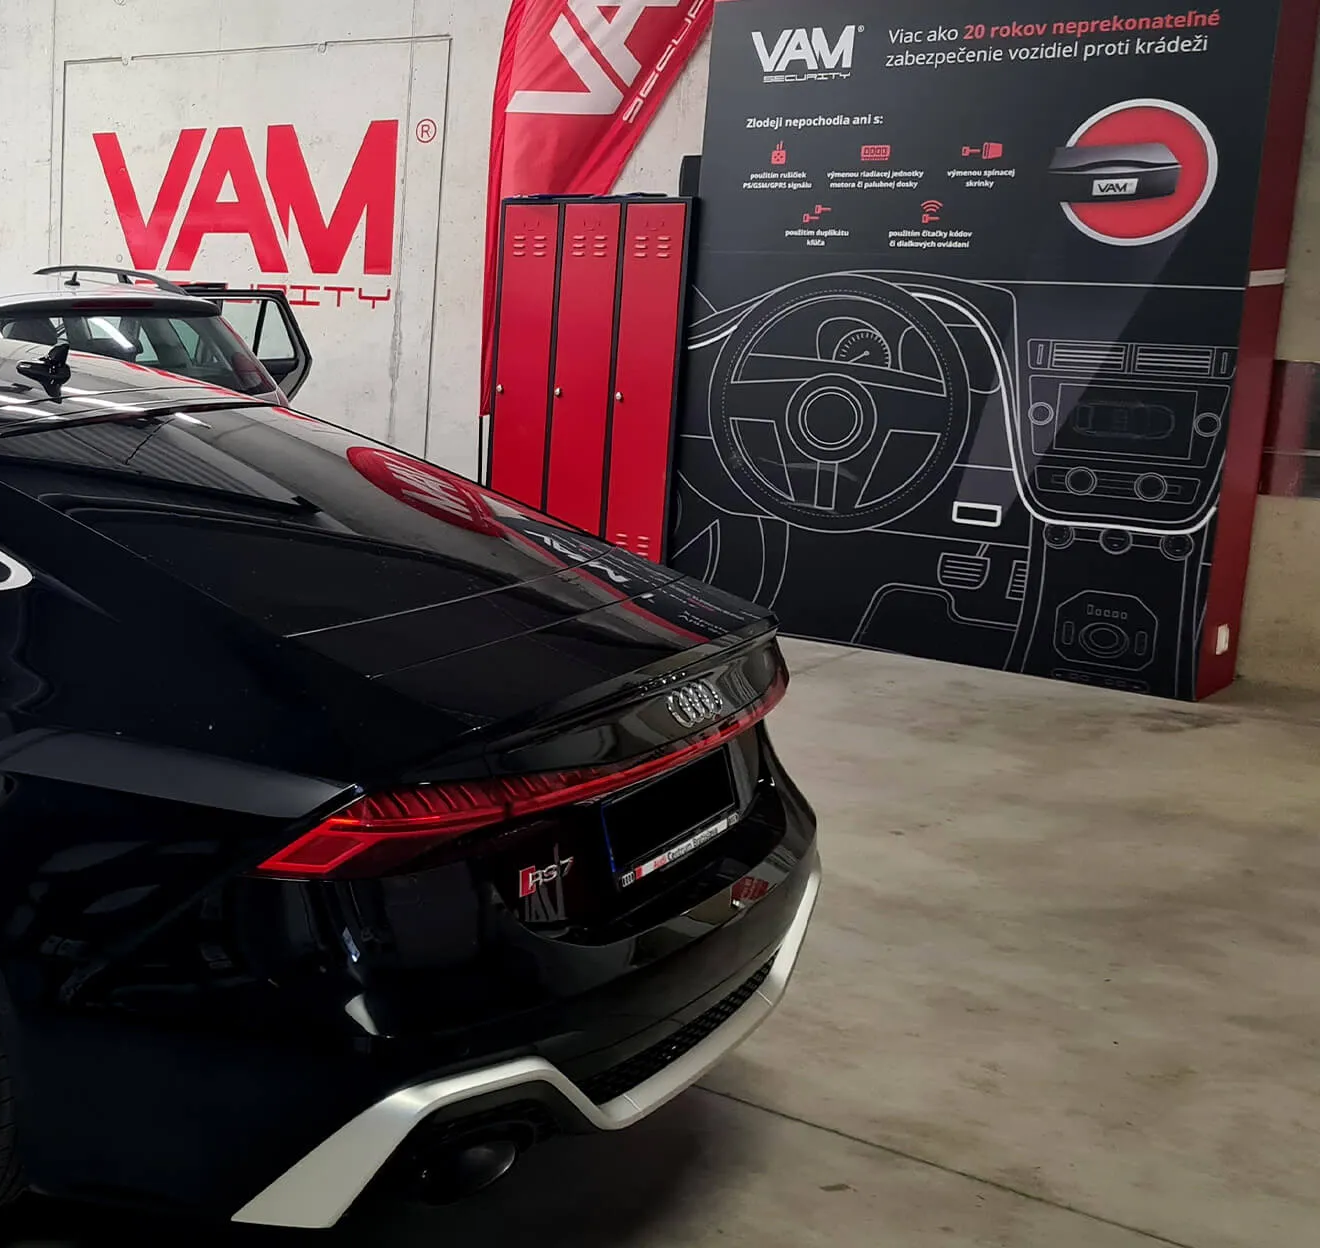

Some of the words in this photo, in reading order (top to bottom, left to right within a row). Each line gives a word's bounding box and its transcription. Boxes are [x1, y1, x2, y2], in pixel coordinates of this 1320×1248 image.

[888, 28, 923, 44] Viac
[927, 26, 959, 42] ako
[963, 24, 986, 40] 20
[990, 21, 1047, 38] rokov
[1052, 9, 1221, 37] neprekonateľné
[751, 25, 856, 73] VAM
[885, 46, 1003, 69] zabezpečenie
[1008, 41, 1078, 60] vozidiel
[1083, 39, 1131, 62] proti
[1135, 34, 1209, 54] krádeži
[763, 71, 851, 83] SECURITY
[746, 116, 783, 130] Zlodeji
[785, 114, 850, 129] nepochodia
[852, 114, 871, 125] ani
[873, 114, 884, 124] s:
[92, 119, 399, 276] VAM
[1097, 182, 1128, 193] VAM
[527, 855, 574, 890] RS7
